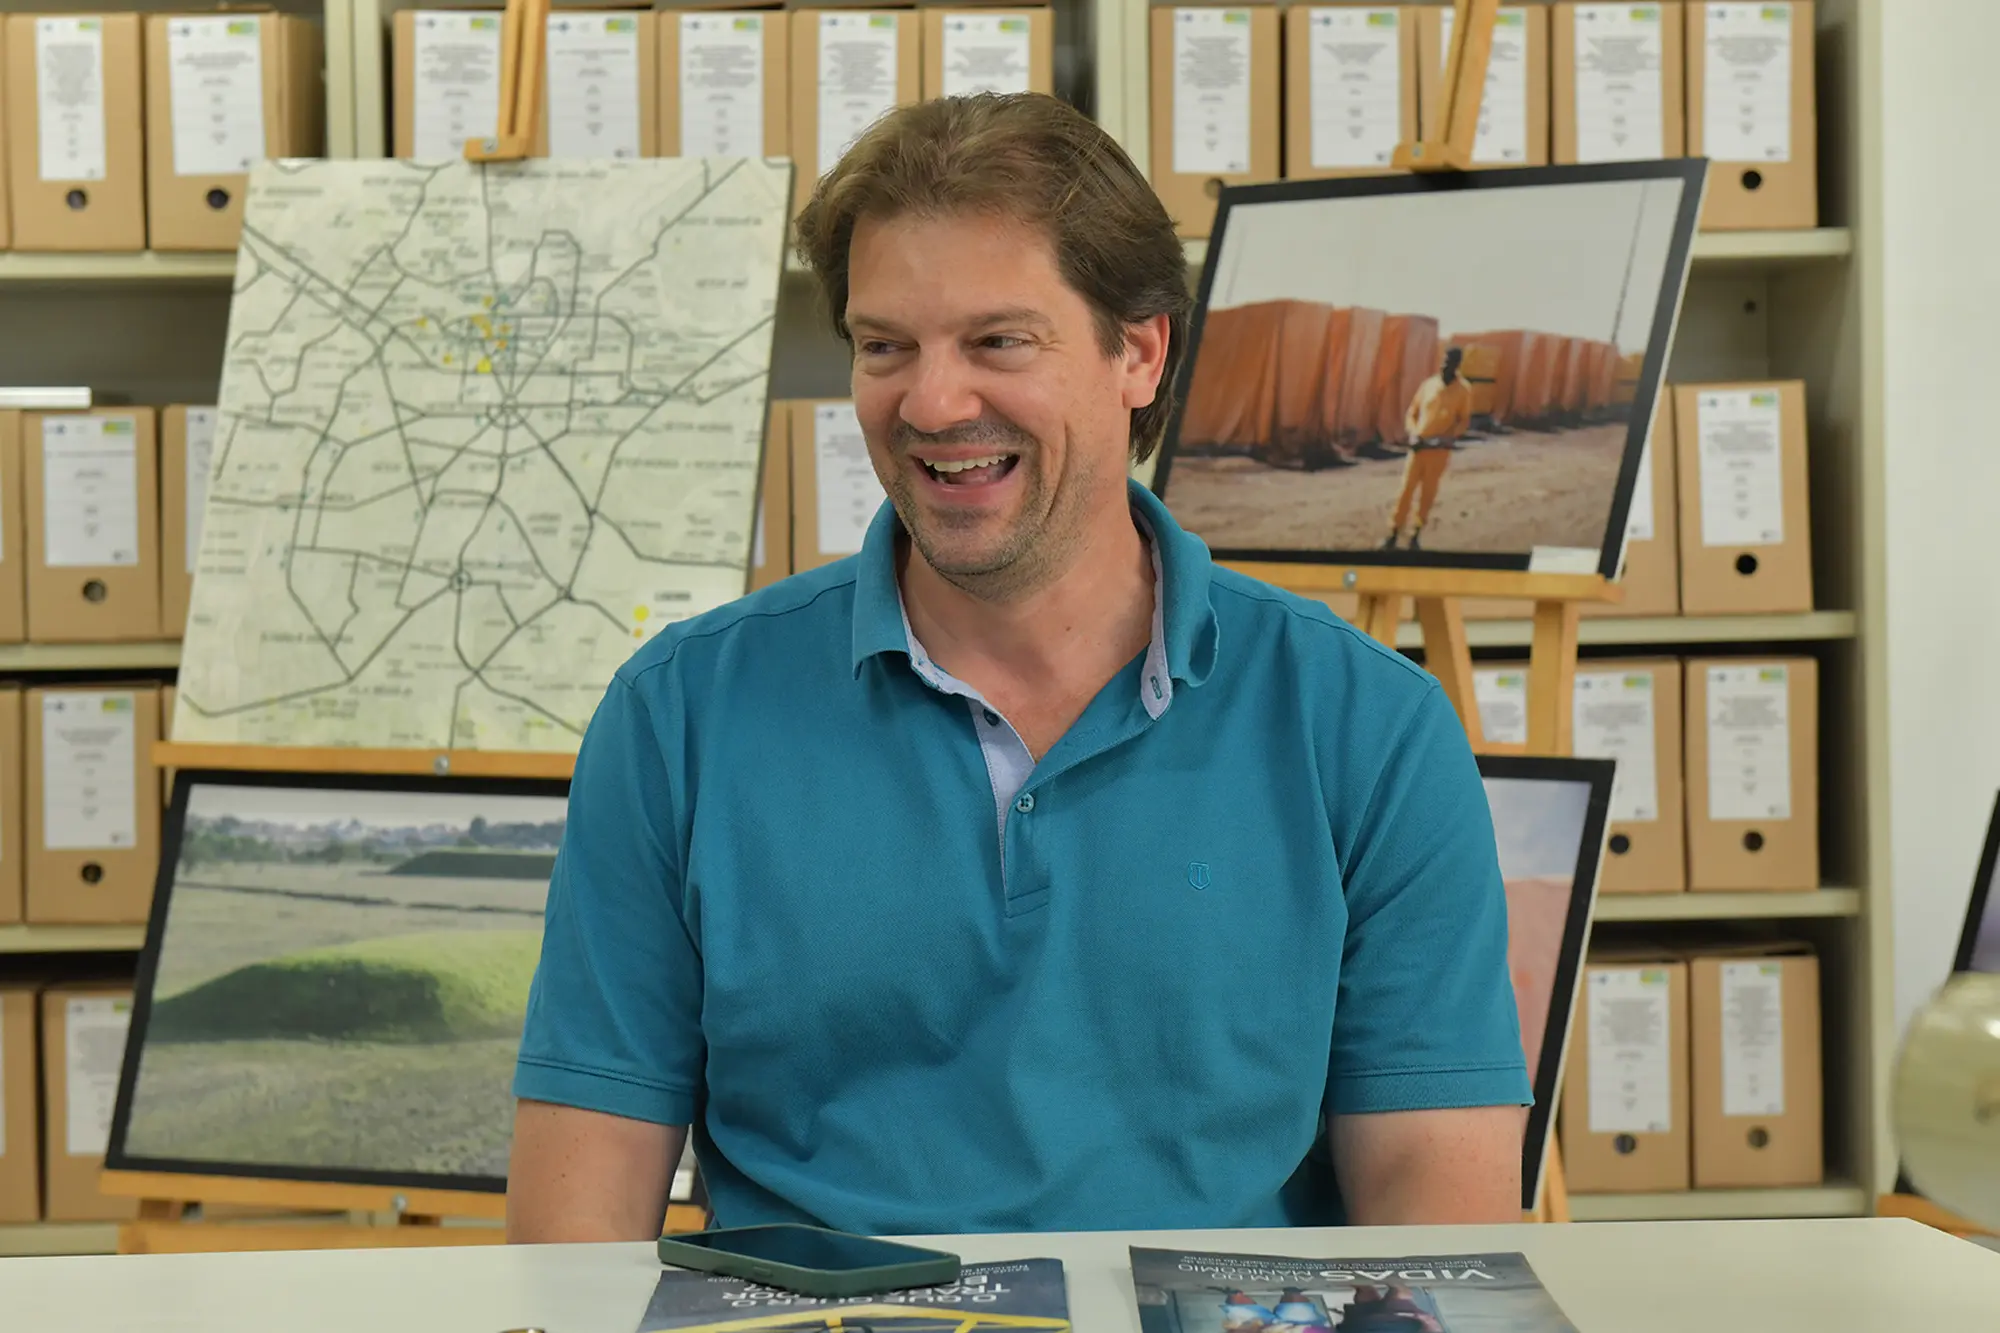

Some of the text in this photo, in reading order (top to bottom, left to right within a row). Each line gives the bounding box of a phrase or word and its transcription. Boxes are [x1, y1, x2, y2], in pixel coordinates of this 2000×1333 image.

[1319, 1268, 1496, 1281] VIDAS
[883, 1294, 962, 1304] QUE
[972, 1294, 997, 1303] O
[731, 1299, 758, 1308] O
